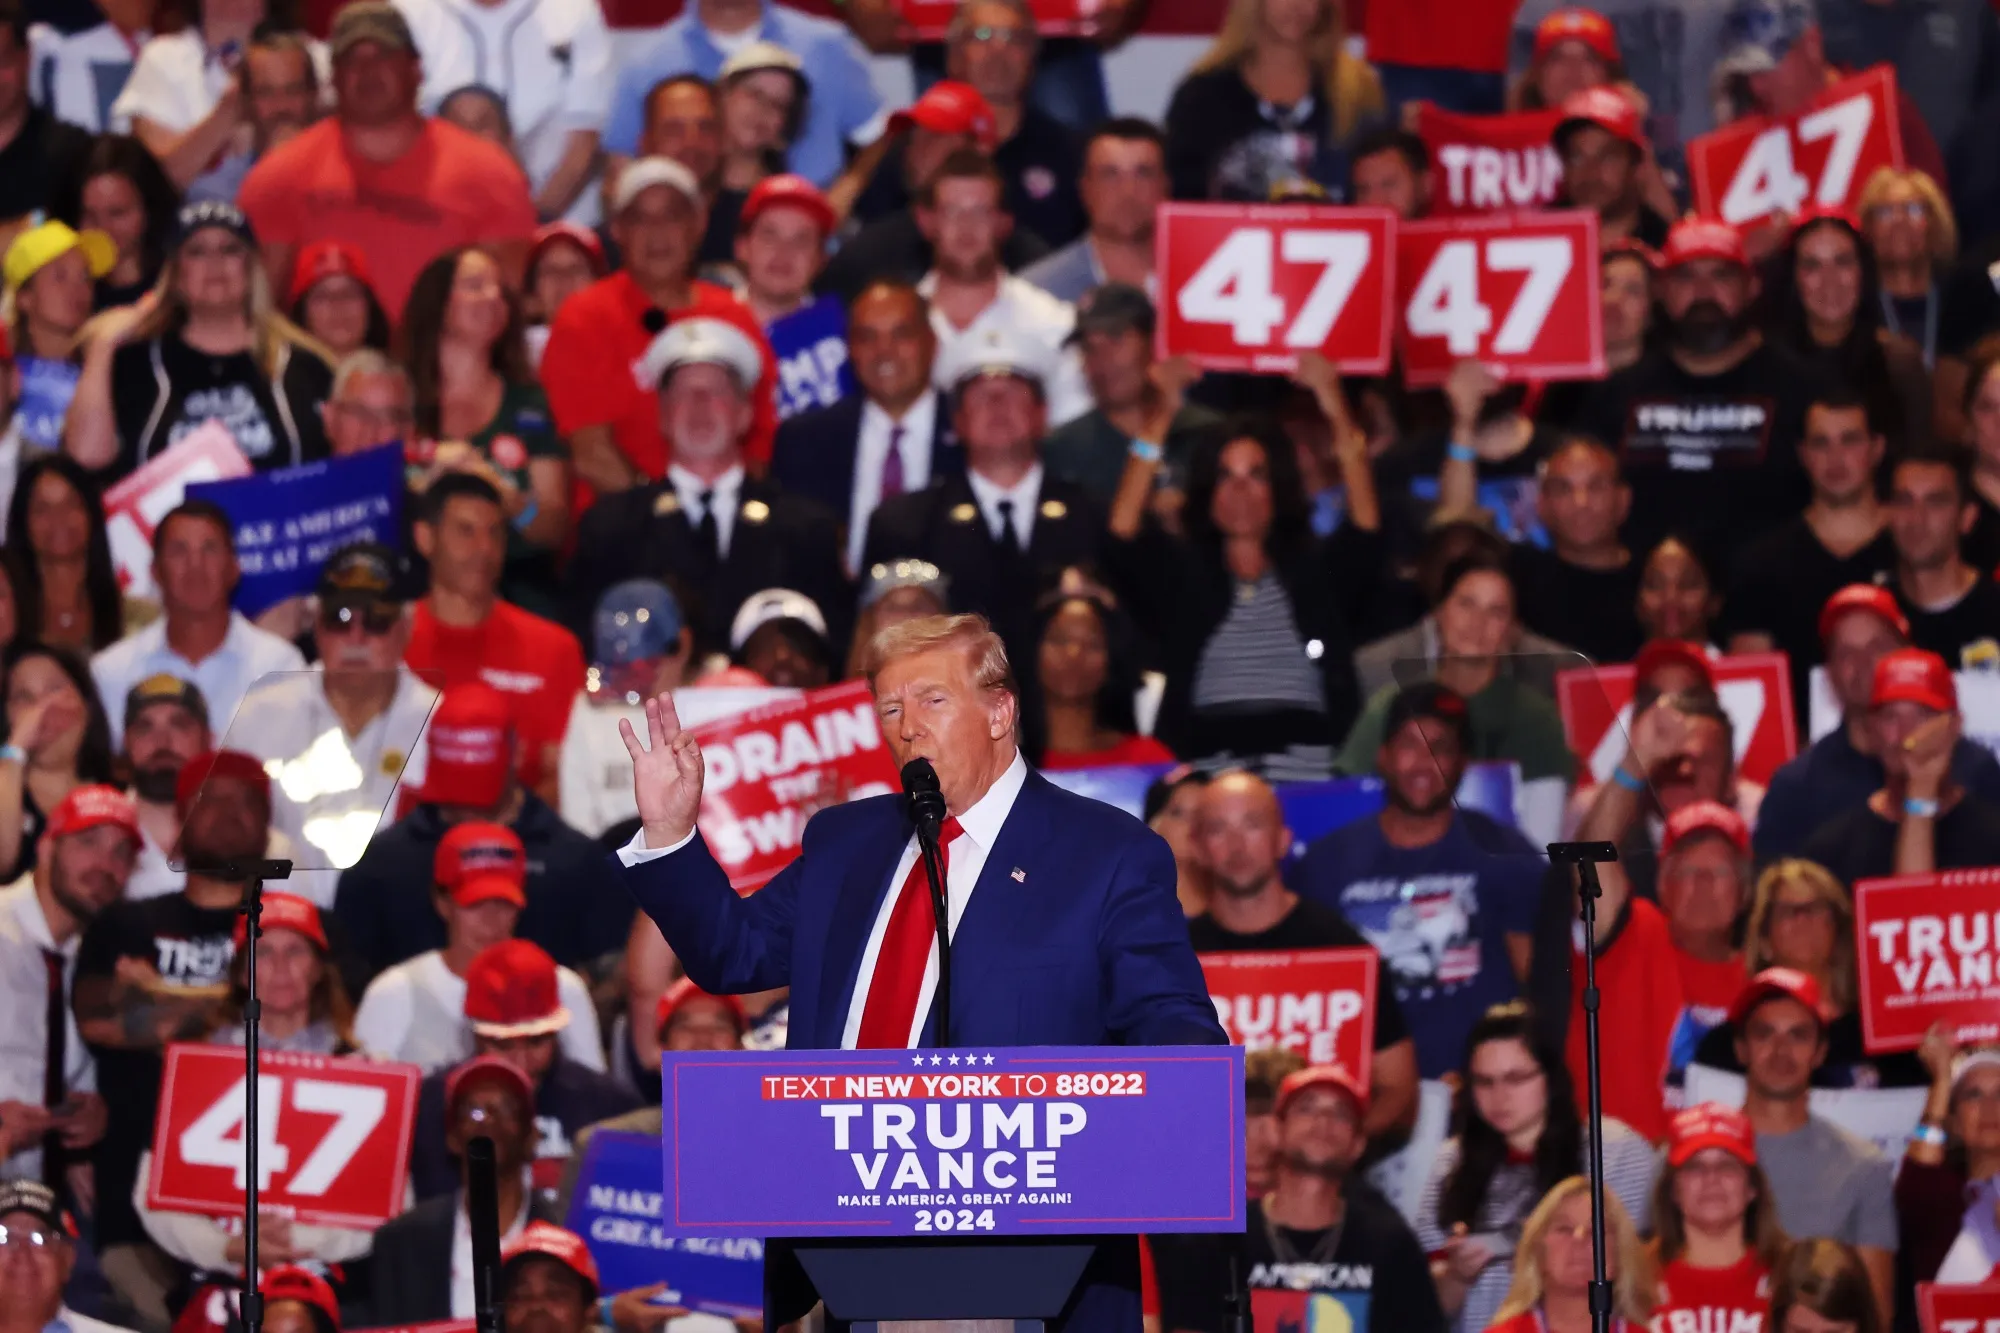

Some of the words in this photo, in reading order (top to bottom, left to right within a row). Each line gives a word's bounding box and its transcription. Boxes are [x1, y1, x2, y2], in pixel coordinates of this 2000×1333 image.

[1720, 92, 1874, 224] 47
[1177, 227, 1372, 348] 47
[1405, 235, 1573, 356] 47
[700, 703, 881, 795] DRAIN
[1868, 909, 2000, 964] TRU
[1892, 950, 2000, 996] VAN
[765, 1077, 836, 1098] TEXT
[845, 1076, 914, 1097] NEW
[921, 1075, 1002, 1097] YORK
[1009, 1074, 1047, 1096] TO
[1055, 1073, 1143, 1096] 88022
[180, 1072, 388, 1198] 47
[820, 1102, 1087, 1150] TRUMP
[850, 1150, 1057, 1190] VANCE
[837, 1194, 881, 1206] MAKE
[886, 1194, 957, 1206] AMERICA
[961, 1193, 1013, 1205] GREAT
[1017, 1192, 1073, 1205] AGAIN!
[914, 1209, 996, 1231] 2024
